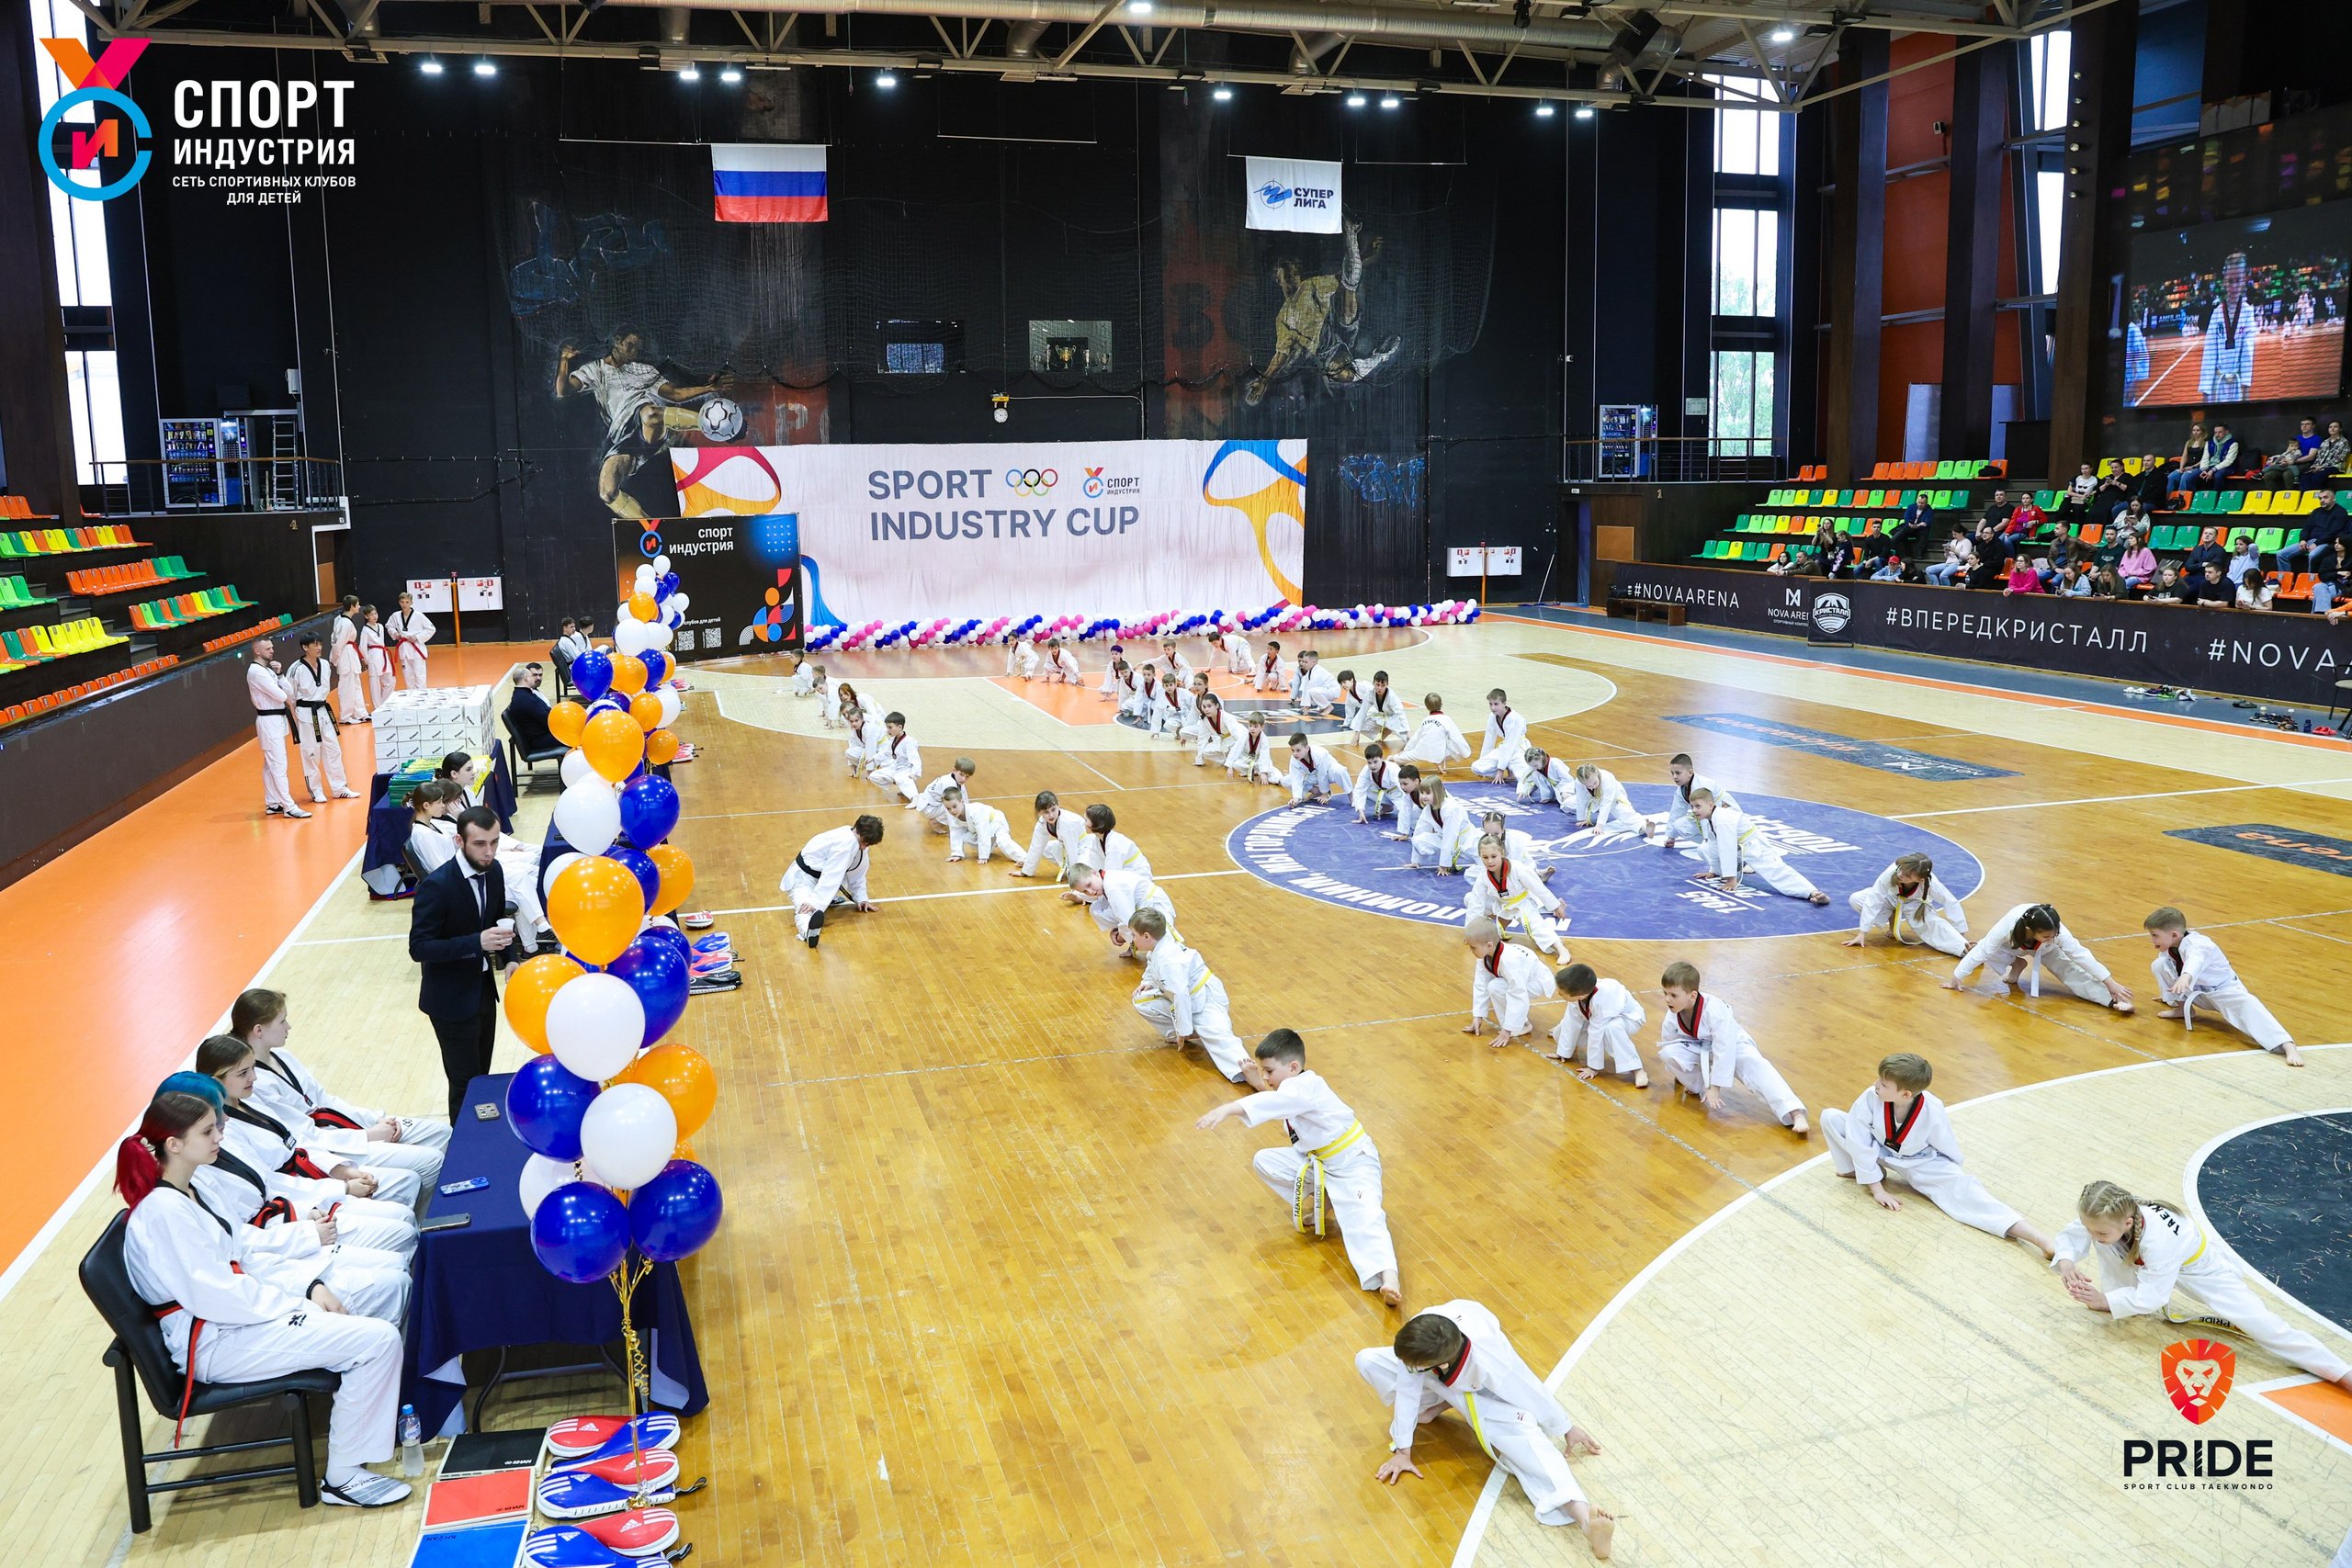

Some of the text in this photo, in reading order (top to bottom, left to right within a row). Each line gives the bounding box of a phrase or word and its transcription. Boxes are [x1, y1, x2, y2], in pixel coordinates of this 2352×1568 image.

[1294, 187, 1334, 198] СУПЕР
[1294, 198, 1327, 209] ЛИГА
[867, 468, 992, 500] SPORT
[1107, 477, 1140, 489] СПОРТ
[1107, 488, 1140, 496] ИНДУСТРИЯ
[288, 519, 299, 531] 4
[870, 505, 1140, 541] INDUSTRY CUP
[697, 526, 733, 540] спорт
[669, 539, 734, 557] индустрия
[1634, 581, 1740, 608] #NOVAARENA
[1767, 607, 1809, 621] NOVA ARE
[1815, 607, 1849, 616] КРИСТАЛЛ
[1885, 606, 2148, 654] #ВПЕРЕДКРИСТАЛЛ
[2208, 637, 2352, 675] #NOVA
[1243, 805, 1337, 852] ГОРДИМСЯ!
[1248, 853, 1309, 874] МЫ
[1674, 890, 1749, 914] 1945
